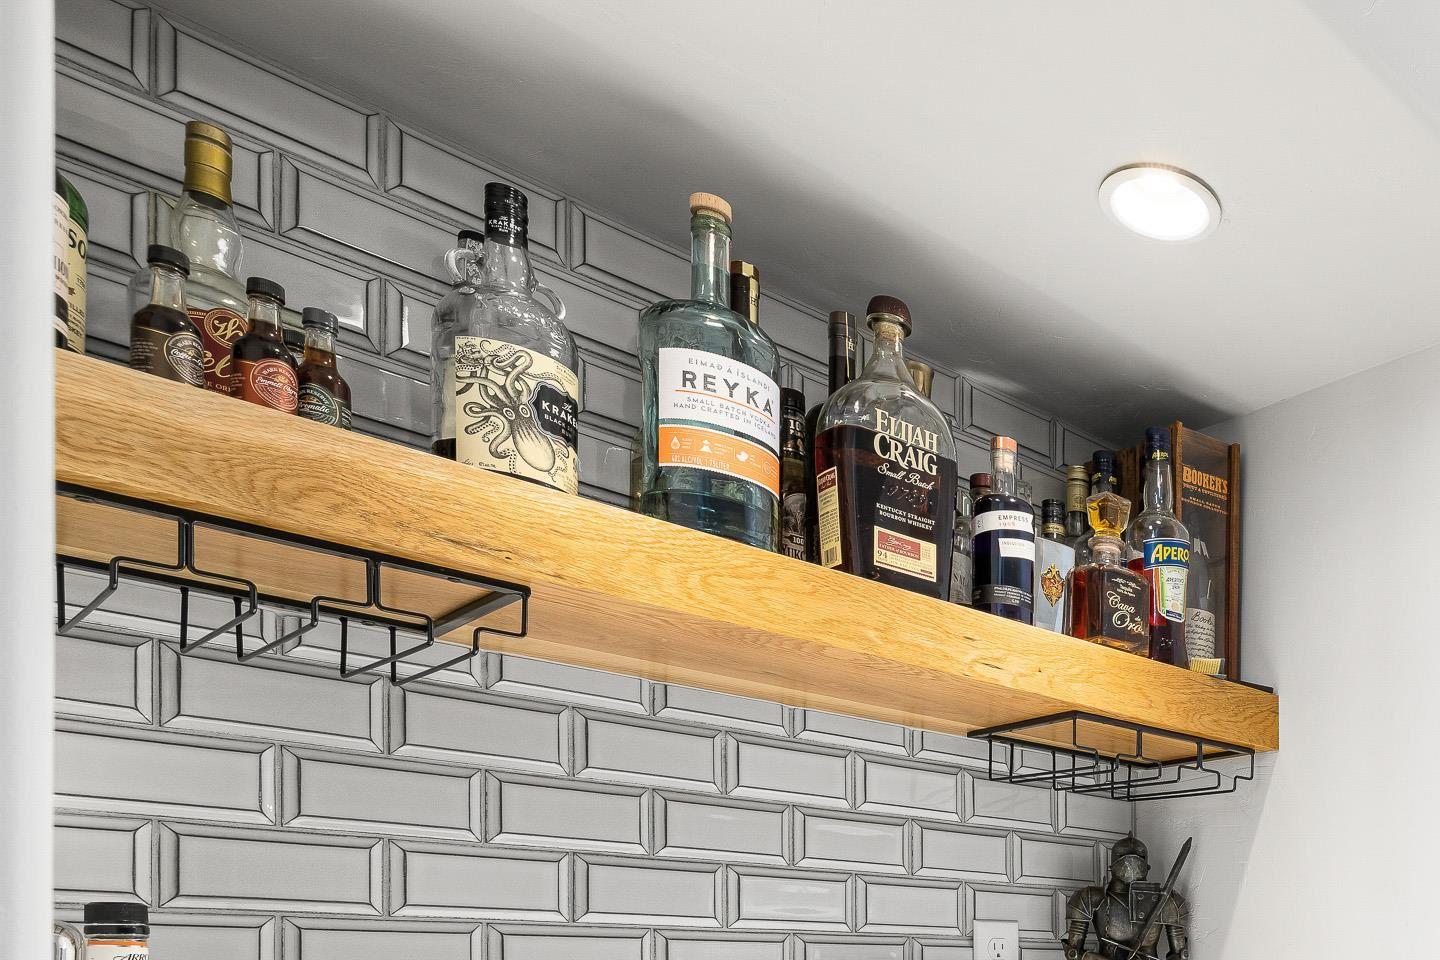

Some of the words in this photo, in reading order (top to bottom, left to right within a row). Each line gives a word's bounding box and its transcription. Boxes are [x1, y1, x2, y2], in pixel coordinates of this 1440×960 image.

[681, 369, 774, 418] REYKA
[673, 402, 698, 411] HAND
[700, 406, 741, 421] CRAFTED
[686, 395, 716, 408] SMALL
[719, 402, 748, 417] BATCH
[874, 408, 939, 455] ELIJAH
[873, 433, 938, 476] CRAIG
[877, 463, 905, 481] Small
[904, 472, 934, 491] Batch
[1182, 465, 1229, 495] BOOKER'S
[876, 502, 907, 517] KENTUCKY
[906, 510, 936, 526] STRAIGHT
[879, 510, 907, 524] BOURBON
[906, 517, 933, 531] WHISKEY
[997, 514, 1029, 524] EMPRESS
[1106, 590, 1136, 613] Cava
[1112, 610, 1144, 635] Oro
